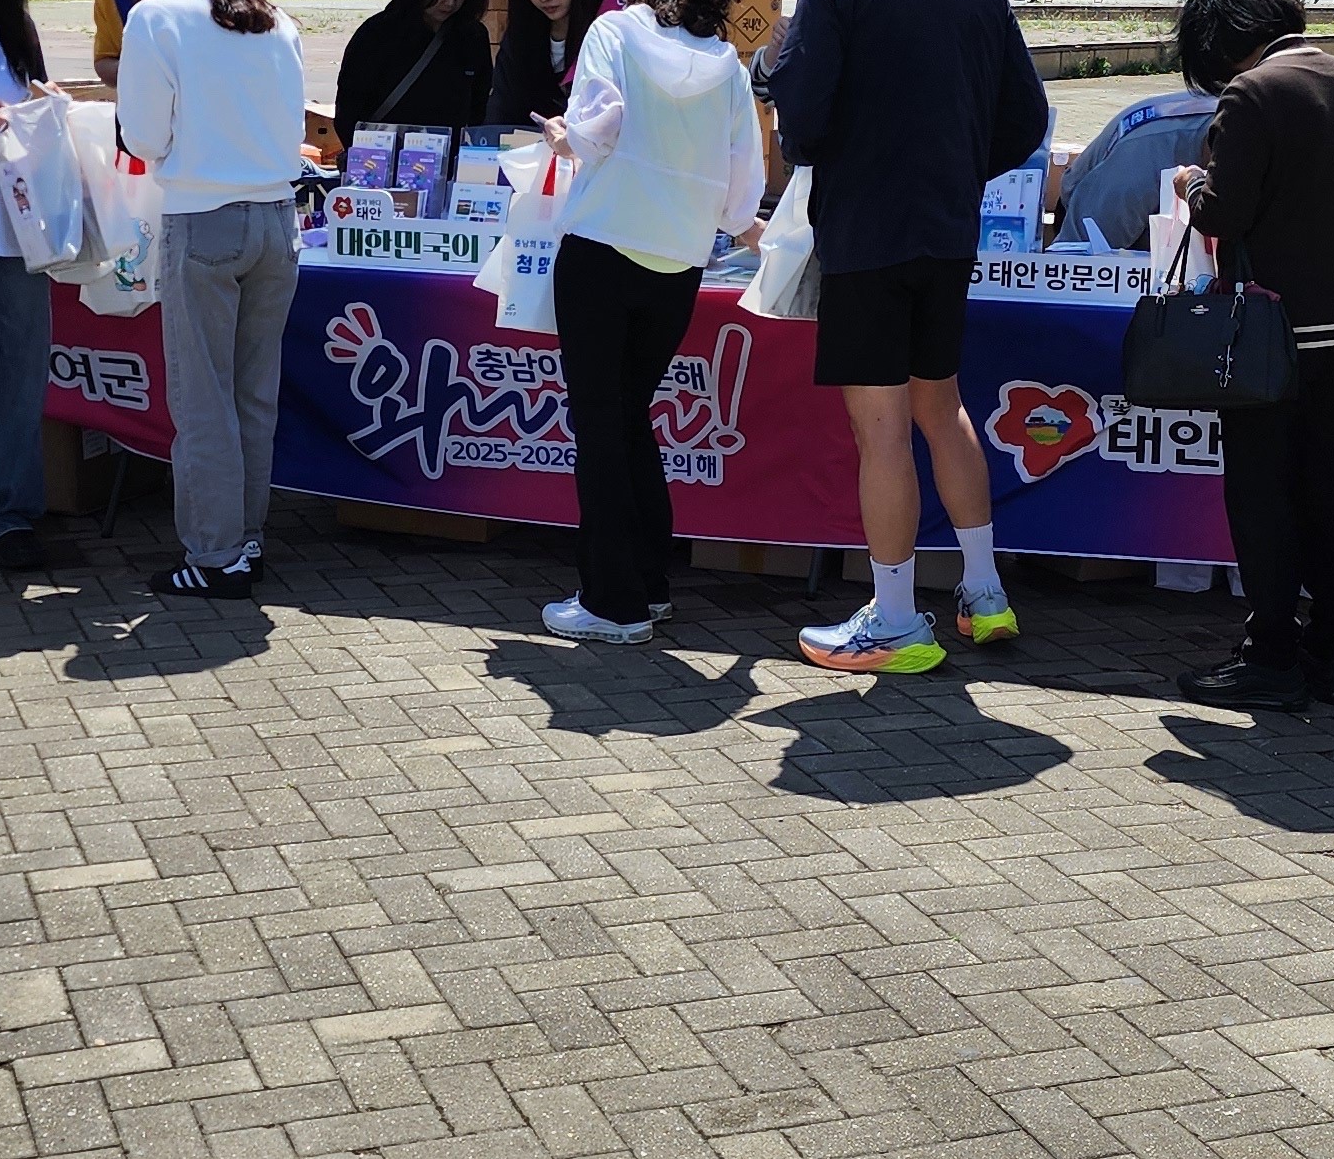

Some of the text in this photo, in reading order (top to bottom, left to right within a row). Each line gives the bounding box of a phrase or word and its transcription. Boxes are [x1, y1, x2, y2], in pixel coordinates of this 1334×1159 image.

[742, 17, 762, 32] 국내산
[355, 207, 382, 221] 태안
[336, 227, 479, 264] 대한민국의
[539, 241, 555, 250] 알프
[988, 261, 1039, 289] 태안
[1044, 264, 1121, 294] 방문의
[1126, 267, 1152, 295] 해
[51, 350, 148, 407] 여군
[475, 348, 566, 385] 충남이
[451, 441, 576, 469] 2025-2026
[1108, 415, 1222, 467] 태안
